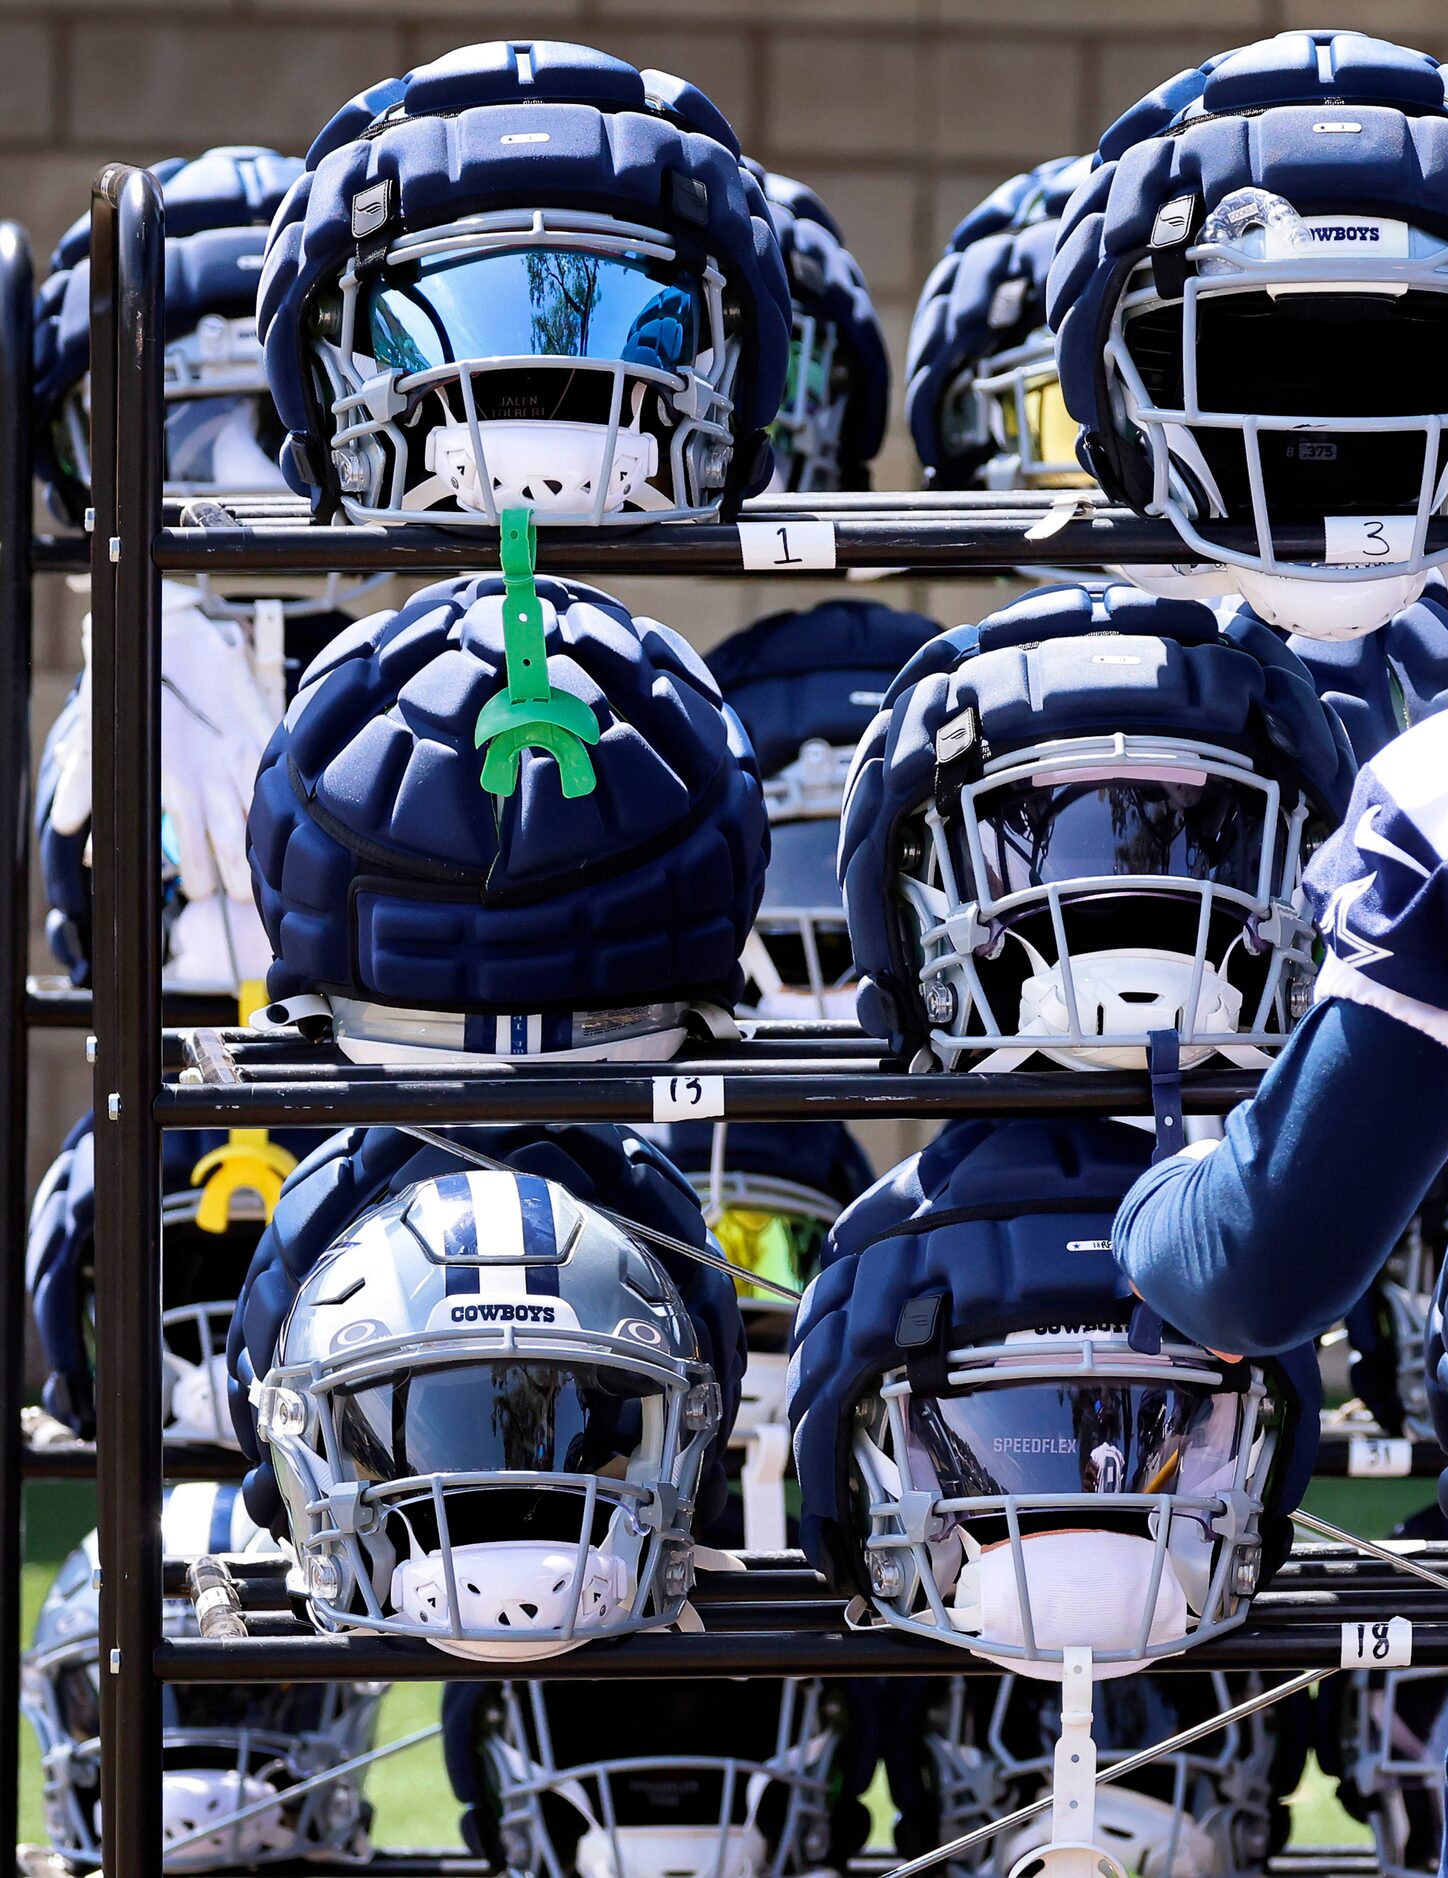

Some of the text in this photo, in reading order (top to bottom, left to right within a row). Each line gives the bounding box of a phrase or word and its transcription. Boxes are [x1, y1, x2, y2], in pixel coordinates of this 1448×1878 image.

[1310, 226, 1380, 242] WBOYS
[773, 527, 803, 564] 1
[1362, 521, 1390, 556] 3
[451, 1304, 555, 1323] COWBOYS
[993, 1437, 1077, 1454] SPEEDFLEX
[1357, 1623, 1391, 1660] 18
